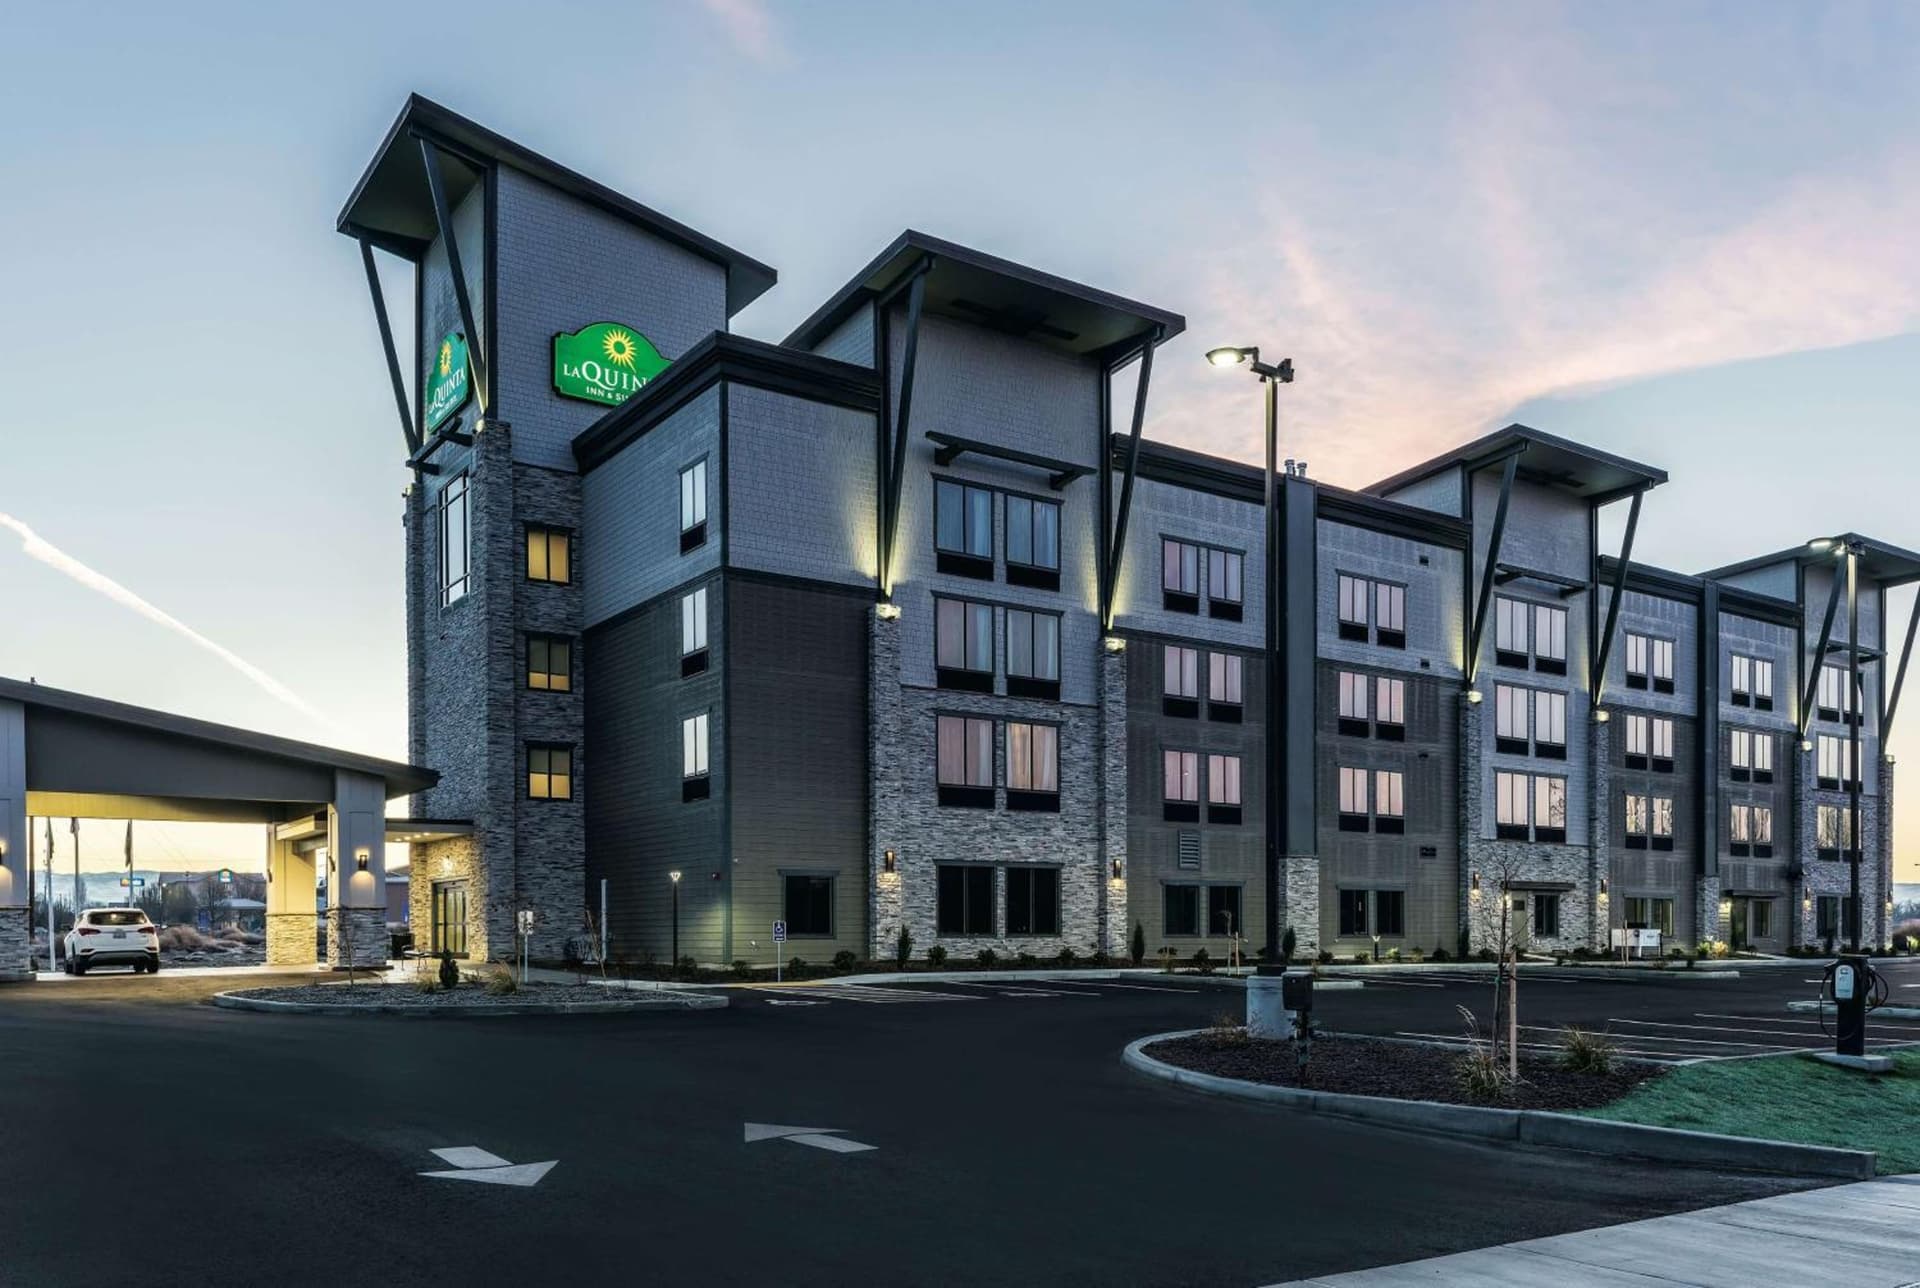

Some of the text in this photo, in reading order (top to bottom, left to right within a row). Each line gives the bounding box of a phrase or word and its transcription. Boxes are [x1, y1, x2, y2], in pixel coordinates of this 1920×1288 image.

[433, 366, 466, 408] QUINTA
[563, 360, 648, 392] LA QUIN
